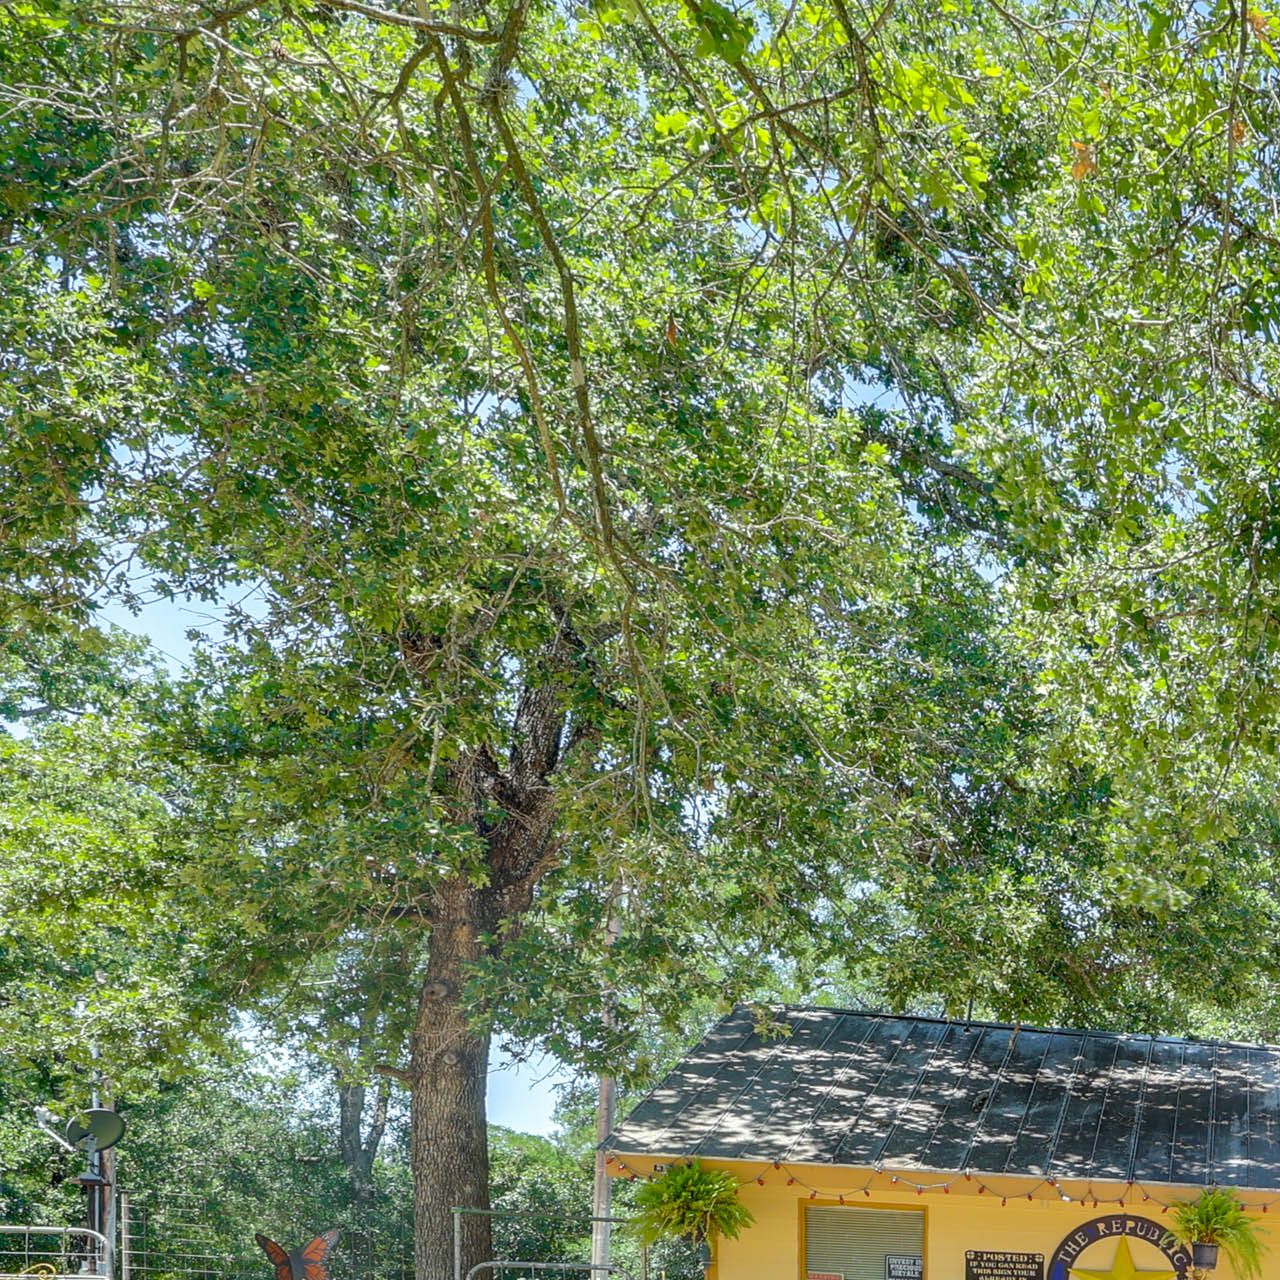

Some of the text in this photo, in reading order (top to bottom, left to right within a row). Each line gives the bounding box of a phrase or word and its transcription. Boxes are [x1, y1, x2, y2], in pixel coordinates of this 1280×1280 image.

[1057, 1219, 1187, 1266] THE REPUBLIC
[983, 1253, 1028, 1262] POSTED
